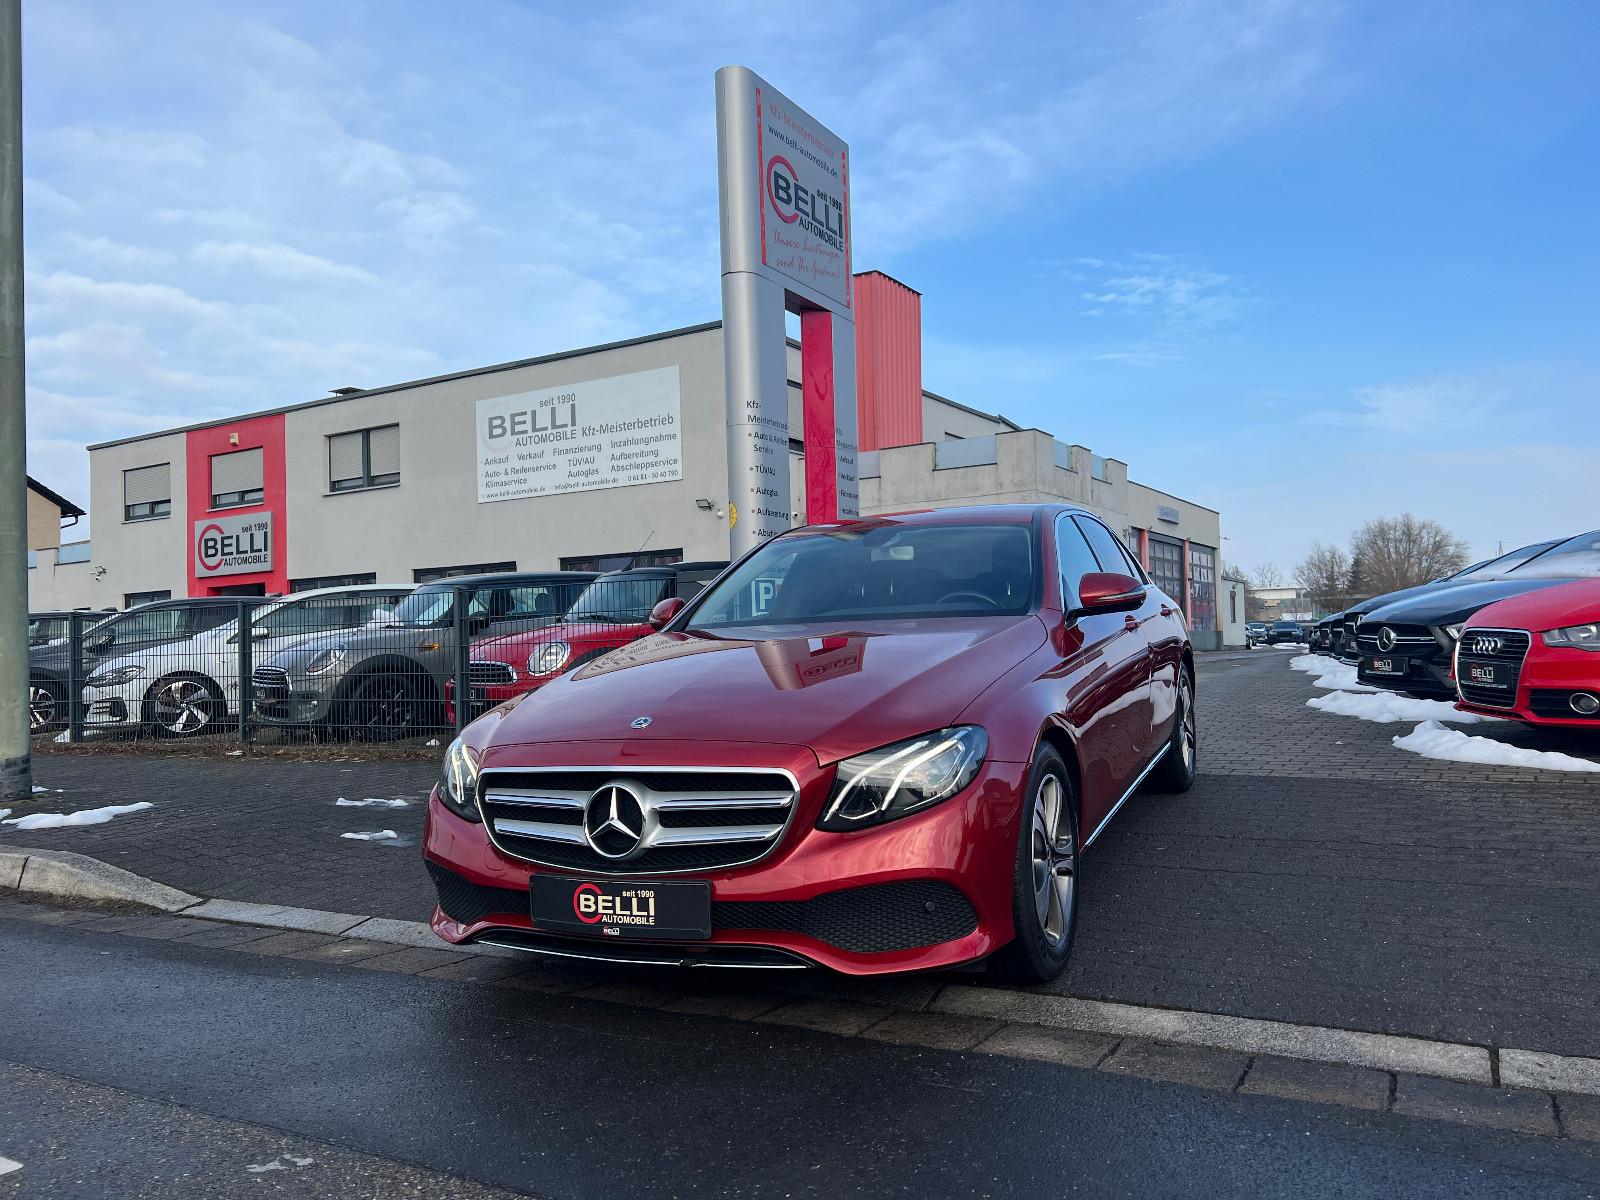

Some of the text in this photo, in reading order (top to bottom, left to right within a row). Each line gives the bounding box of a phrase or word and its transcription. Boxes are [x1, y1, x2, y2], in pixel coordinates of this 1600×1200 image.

[768, 124, 838, 178] www.belli-automobile.de
[774, 170, 843, 240] BELLI
[799, 217, 844, 253] AUTOMOBILE
[539, 393, 576, 408] seit 1990
[746, 400, 762, 409] Kfz-
[488, 403, 577, 440] BELLI
[515, 413, 674, 448] AUTOMOBILE Kfz-Meisterbetrieb
[484, 433, 677, 466] Ankauf Verkauf Finanzierung Inzahlungnahme
[484, 470, 502, 479] Auto-
[504, 468, 509, 476] &
[511, 463, 557, 475] Reifenservice
[610, 449, 659, 462] Aufbereitung
[485, 457, 678, 489] Klimaservice Autoglas Abschleppservice
[241, 522, 268, 533] seit 1990
[203, 530, 268, 559] BELLI
[223, 554, 268, 567] AUTOMOBILE
[760, 583, 774, 609] P
[1472, 668, 1494, 678] BELLI
[579, 893, 655, 916] BELLI
[622, 890, 655, 898] seit 1990
[601, 914, 656, 926] AUTOMOBILE
